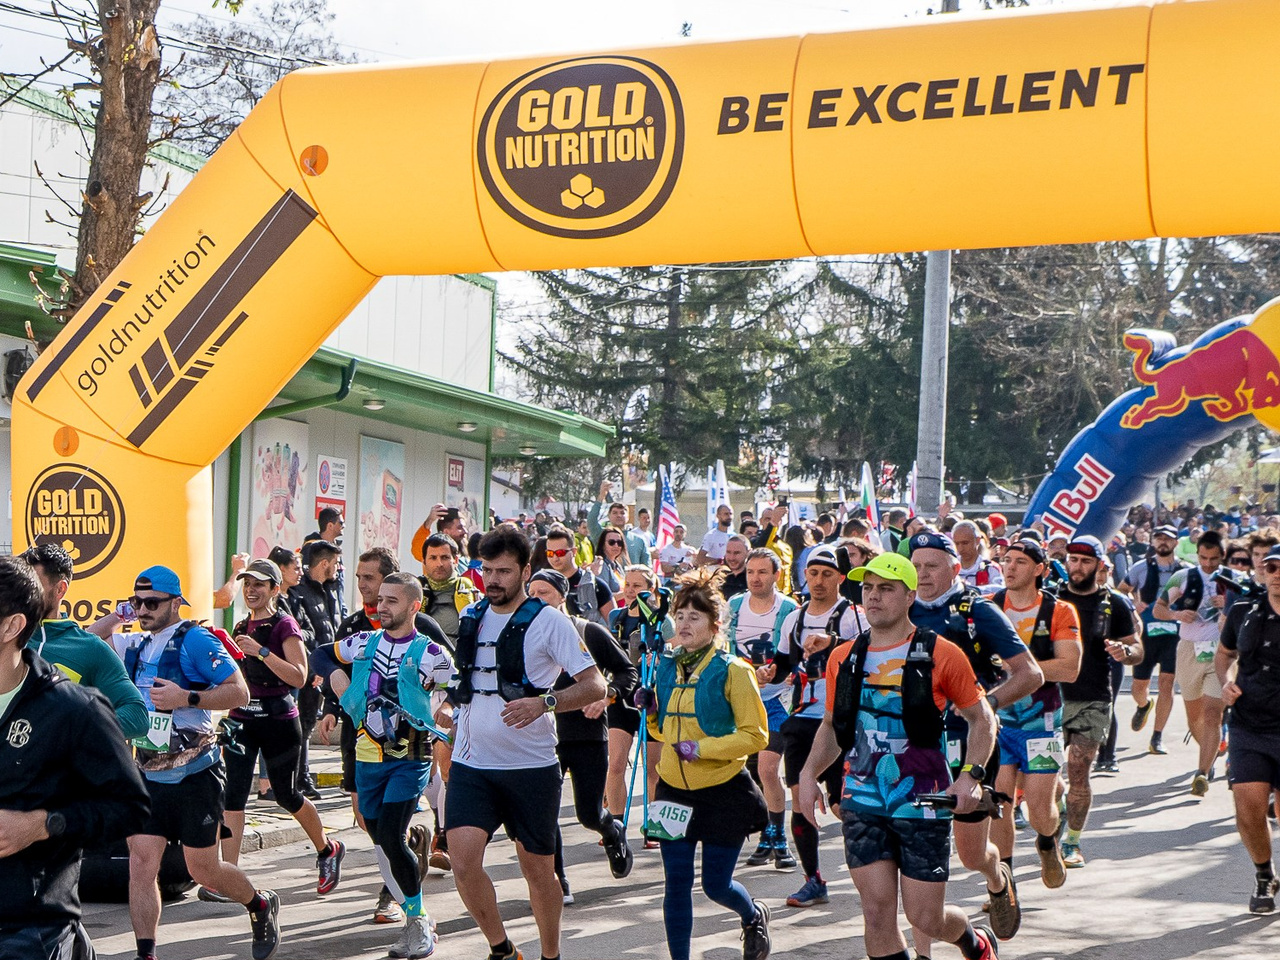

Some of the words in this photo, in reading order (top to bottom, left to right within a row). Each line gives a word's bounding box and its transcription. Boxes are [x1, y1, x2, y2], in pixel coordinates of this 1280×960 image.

[516, 81, 647, 133] GOLD
[717, 92, 789, 136] BE
[806, 63, 1146, 130] EXCELLENT
[505, 126, 655, 169] NUTRITION
[77, 232, 217, 397] goldnutrition
[37, 488, 103, 516] GOLD
[1051, 455, 1113, 523] Bull
[33, 515, 110, 536] NUTRITION
[149, 715, 170, 732] 197
[1045, 741, 1063, 753] 410
[658, 805, 689, 823] 4156
